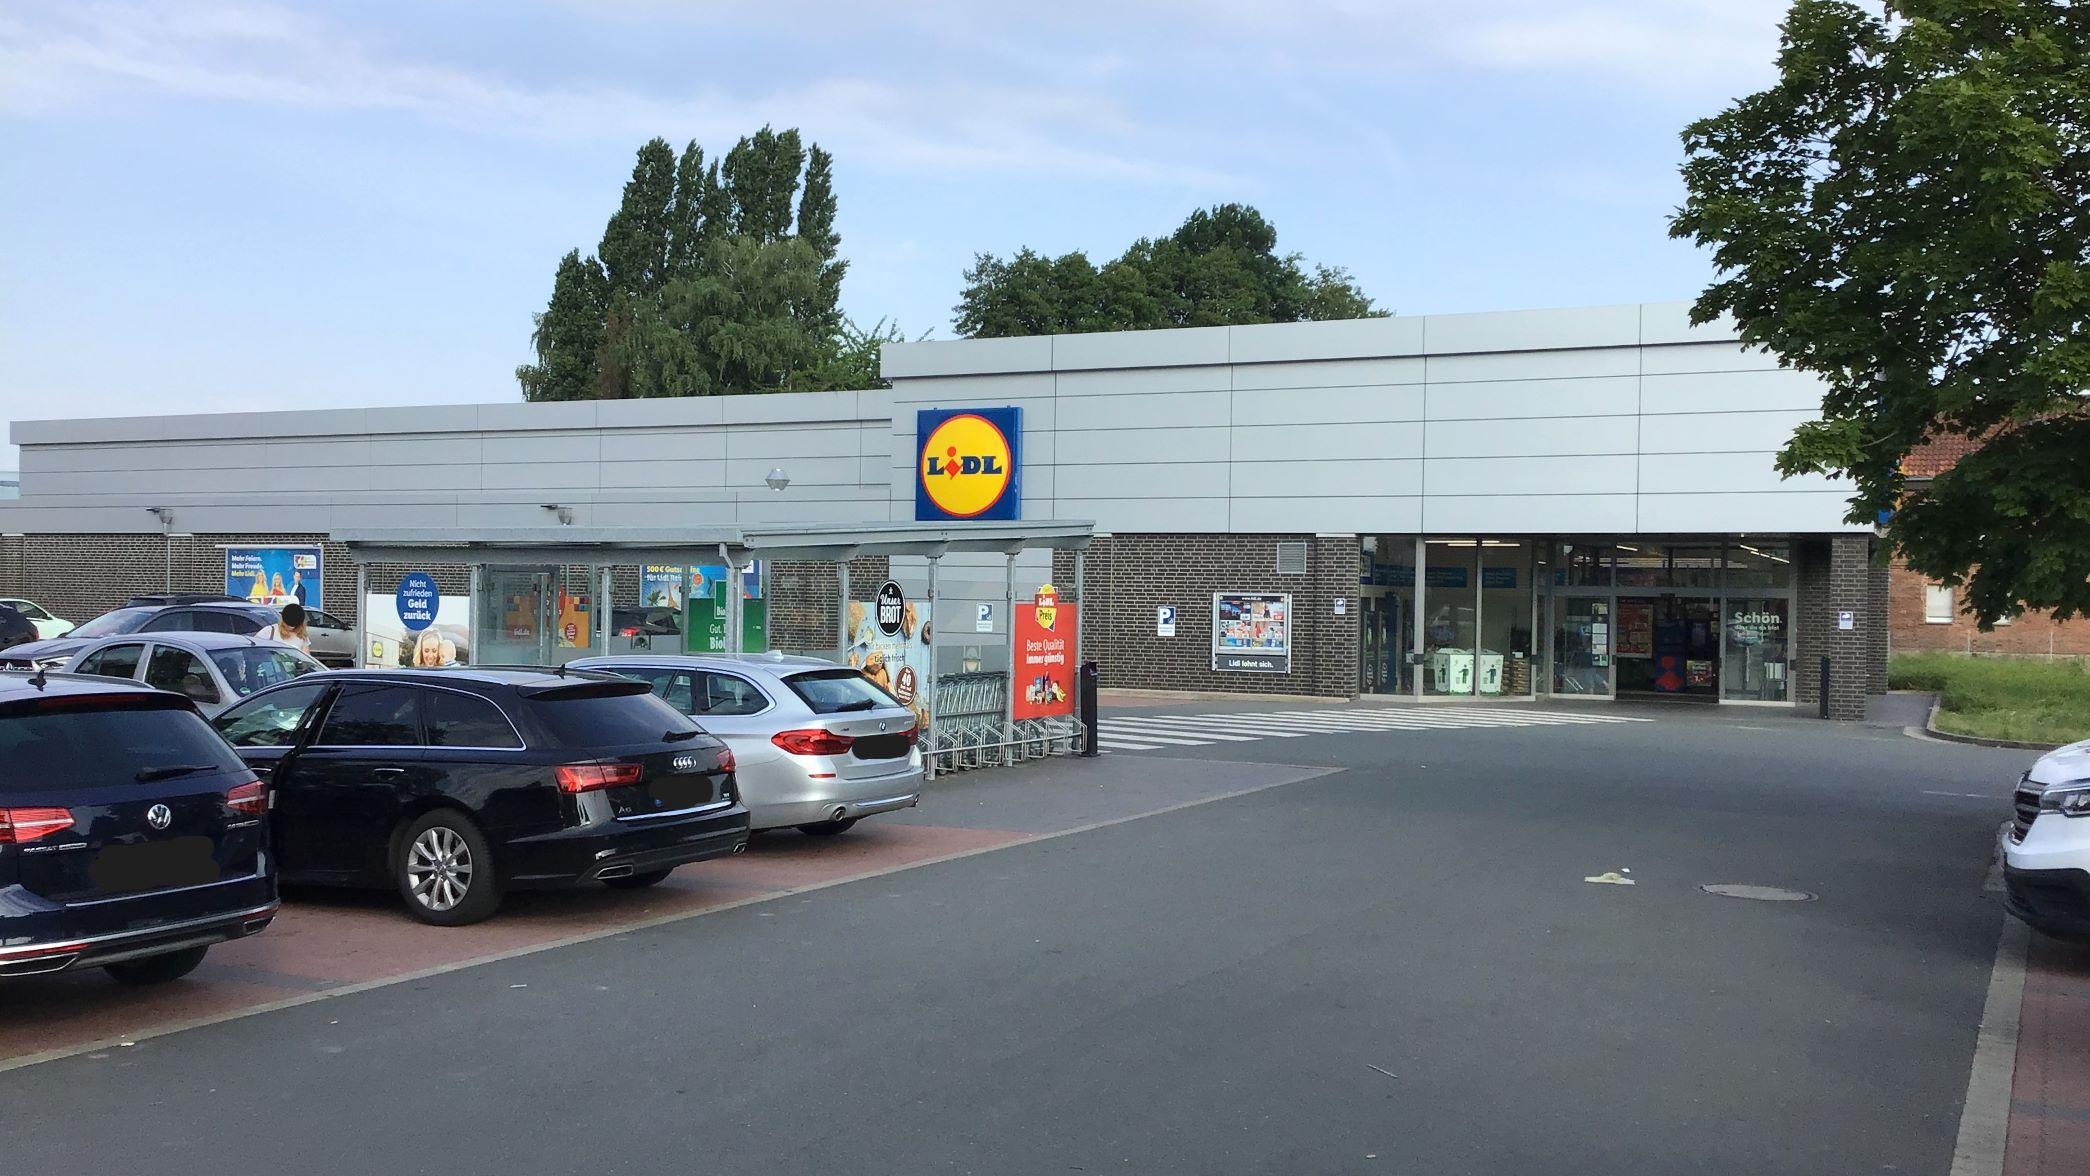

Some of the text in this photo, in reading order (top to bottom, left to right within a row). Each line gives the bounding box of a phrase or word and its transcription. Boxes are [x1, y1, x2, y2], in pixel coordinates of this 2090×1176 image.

[647, 565, 660, 573] 500
[409, 579, 427, 588] Nicht
[402, 589, 433, 598] zufrieden
[880, 593, 902, 605] Unser
[407, 598, 428, 609] Geld
[403, 610, 432, 620] zurück
[880, 605, 902, 624] BROT
[1039, 609, 1053, 621] Preis
[1735, 612, 1782, 624] Schön.
[1026, 639, 1065, 653] Beste Qualität
[1044, 652, 1065, 667] günstig
[1228, 659, 1274, 668] Lidl lohnt sich.
[902, 673, 912, 687] 40
